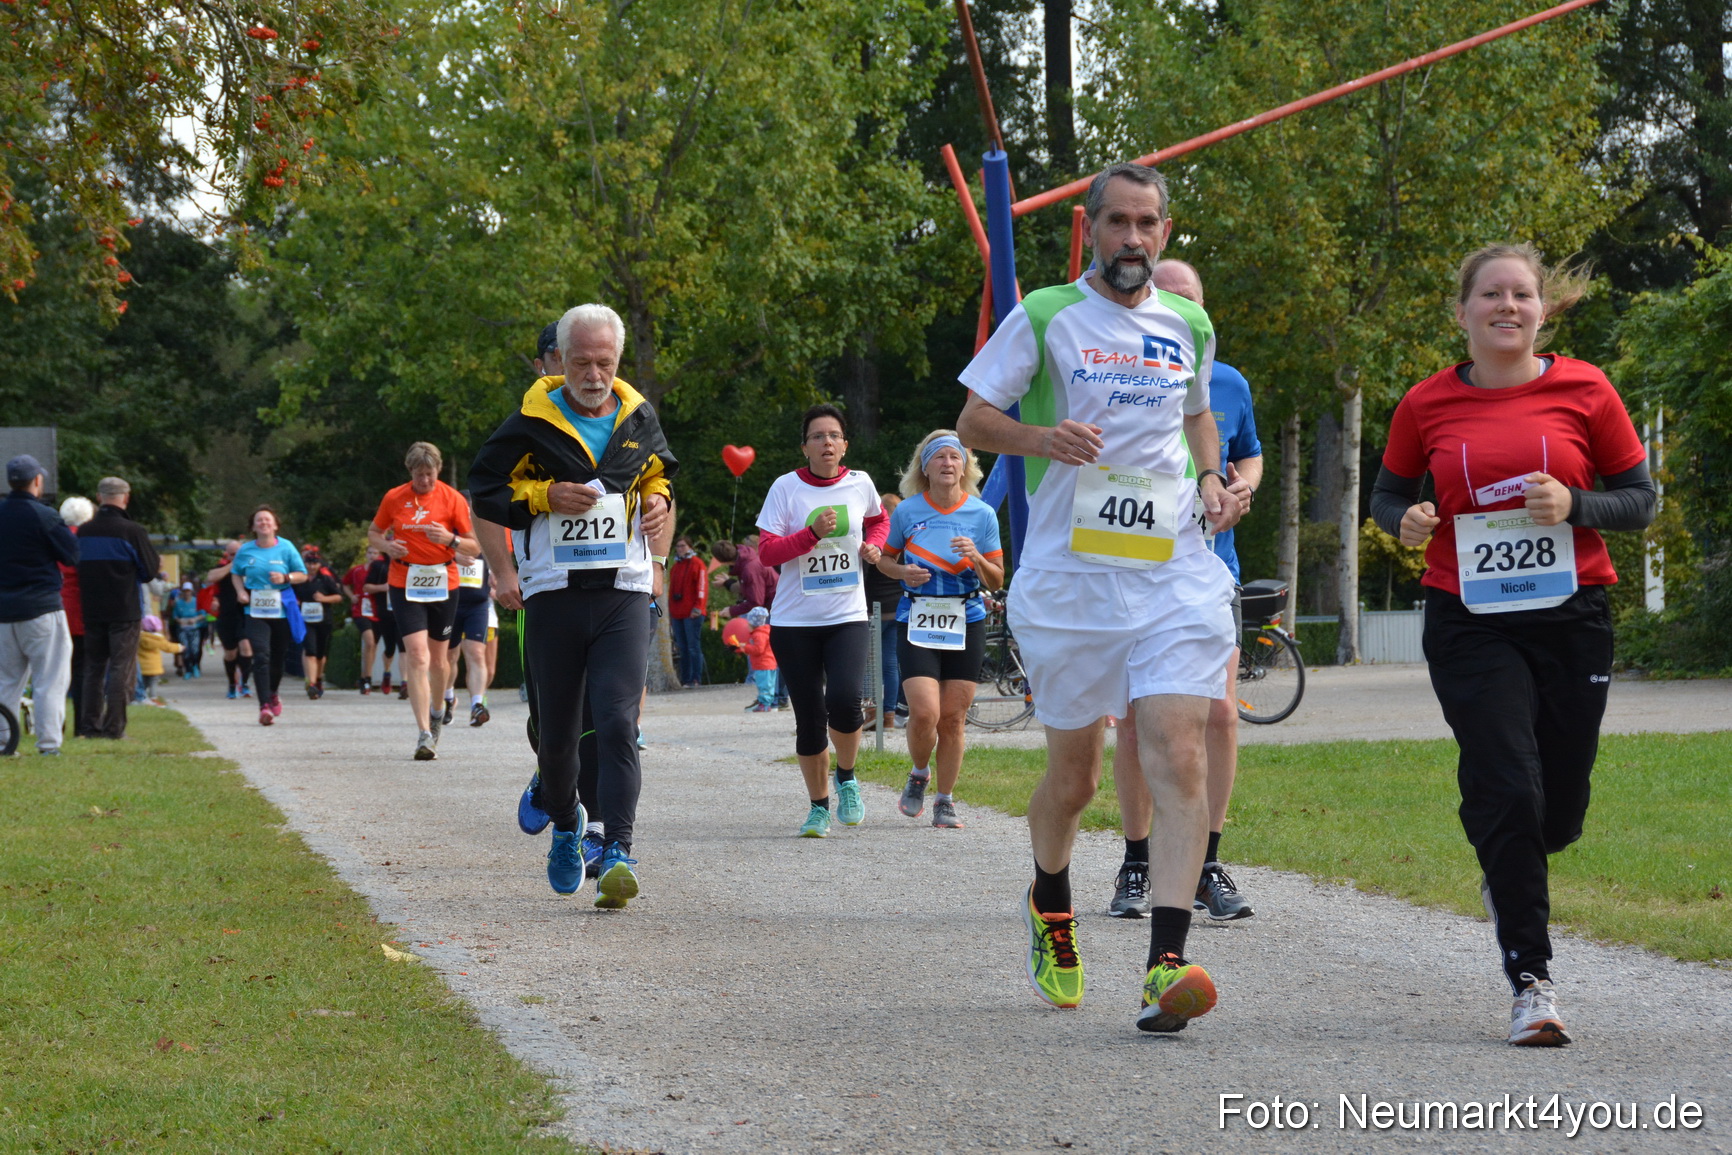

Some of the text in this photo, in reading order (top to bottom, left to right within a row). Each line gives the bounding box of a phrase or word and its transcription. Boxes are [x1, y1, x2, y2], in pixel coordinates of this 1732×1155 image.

[1081, 348, 1138, 368] TEAM
[1107, 391, 1167, 407] FEUCHT
[1118, 474, 1152, 487] BOCK
[1494, 483, 1522, 497] DEHN
[1098, 495, 1155, 530] 404
[561, 517, 615, 541] 2212
[573, 547, 607, 557] Raimund
[1474, 537, 1556, 573] 2328
[808, 553, 850, 573] 2178
[461, 567, 476, 576] 106
[413, 576, 441, 587] 2227
[818, 577, 843, 585] Cornelia
[1501, 581, 1537, 594] Nicole
[255, 598, 276, 607] 2302
[917, 613, 958, 630] 2107
[927, 633, 946, 641] Conny
